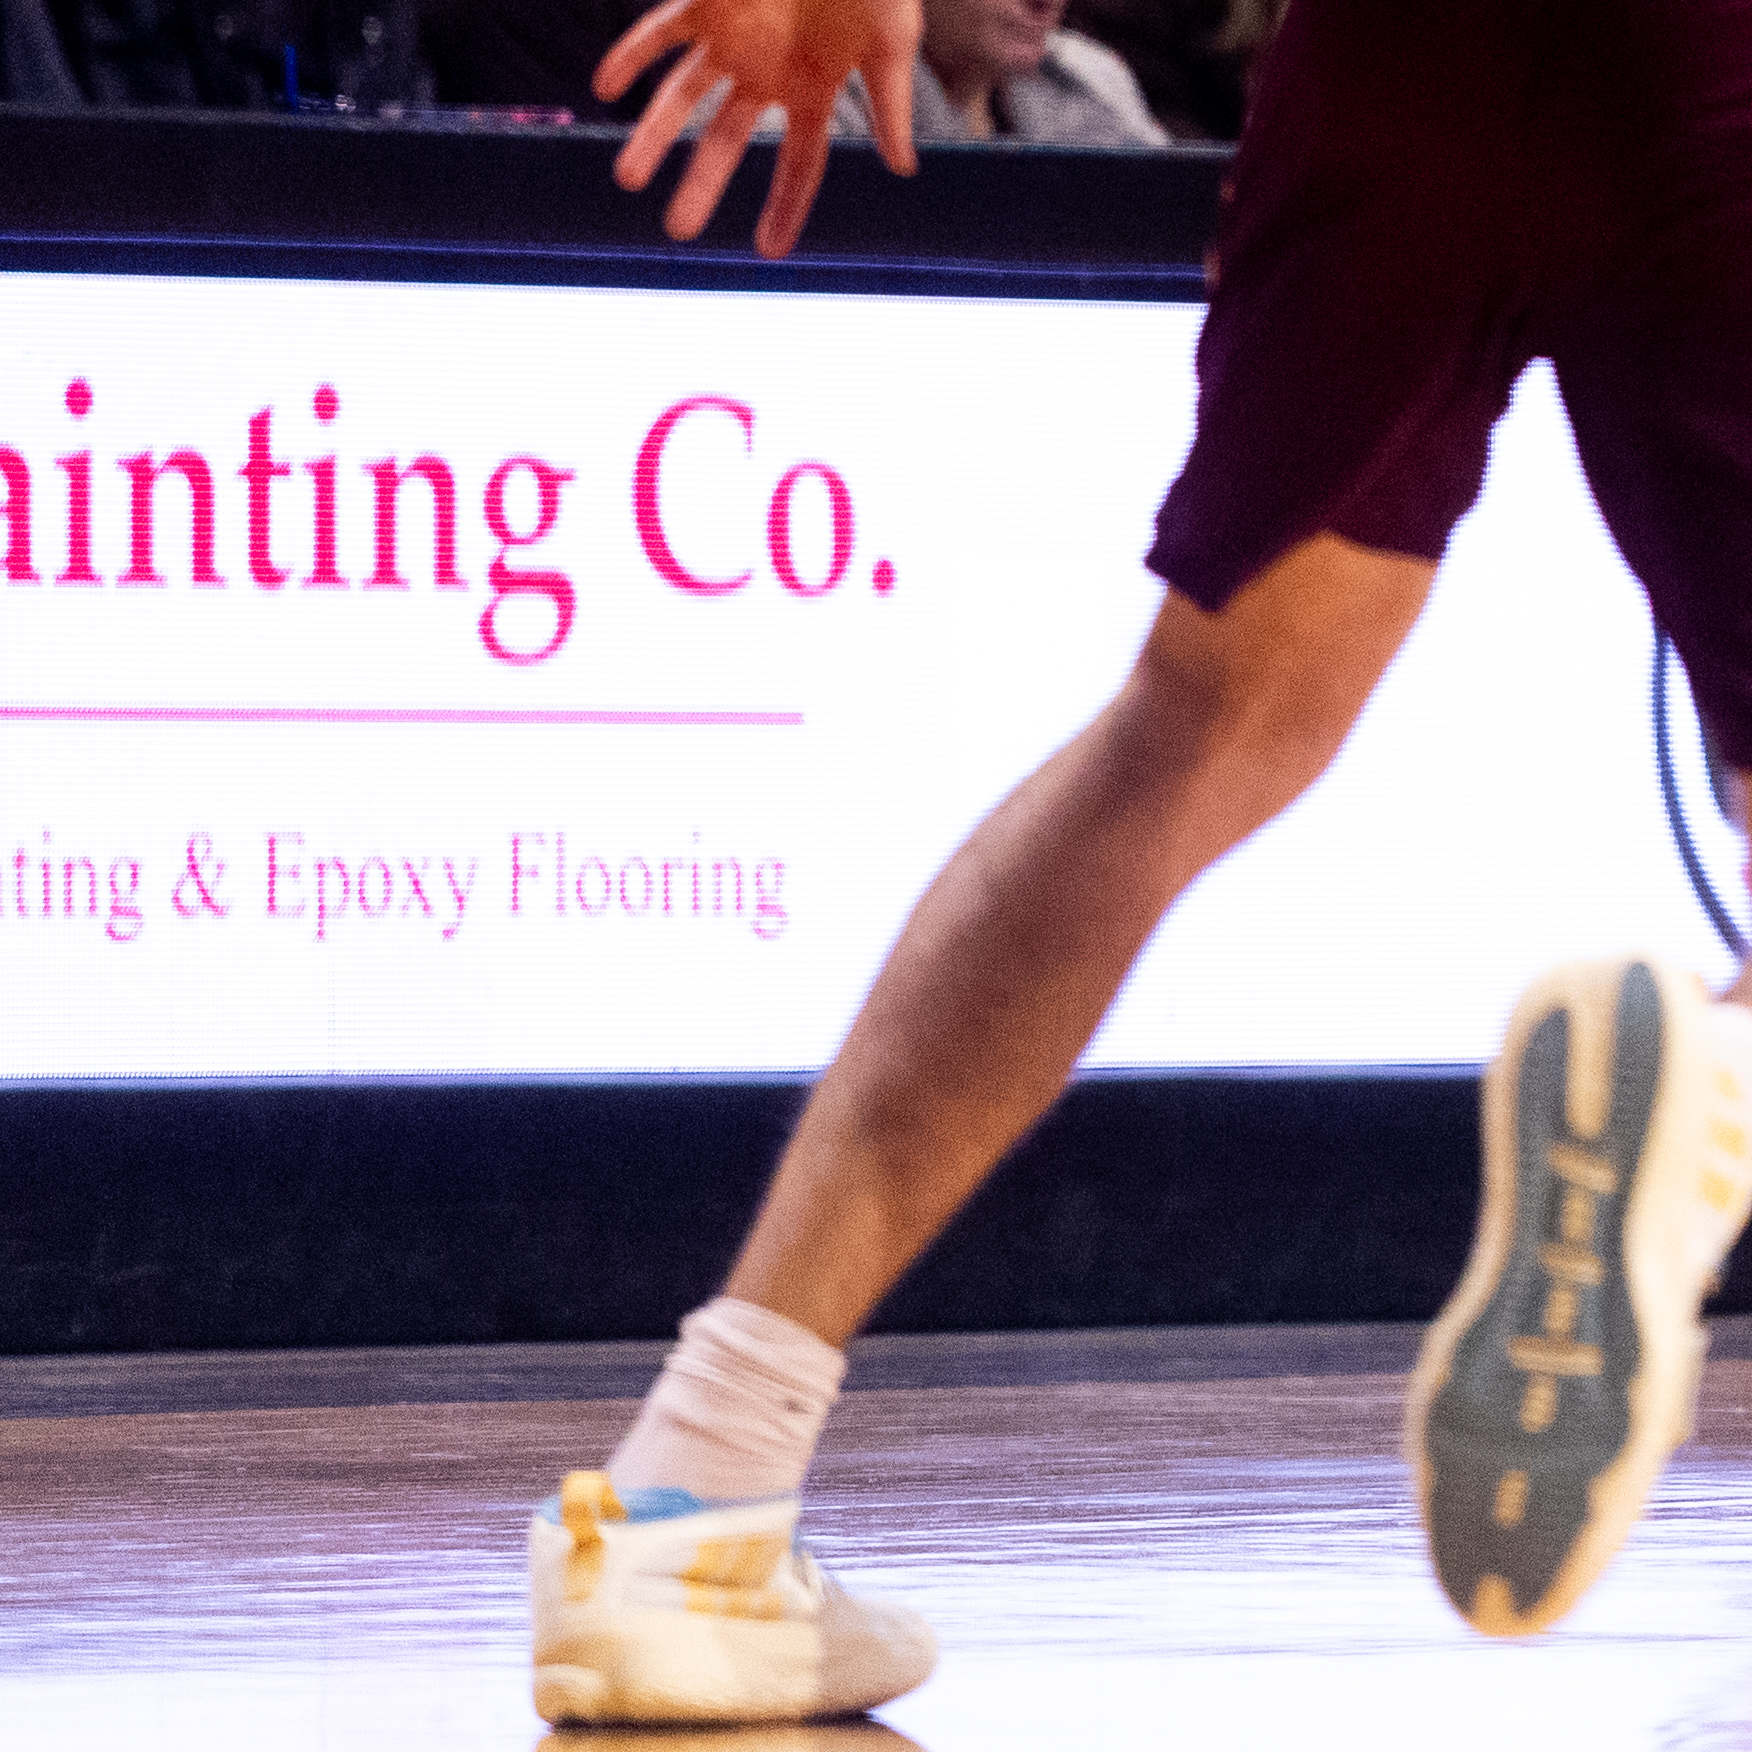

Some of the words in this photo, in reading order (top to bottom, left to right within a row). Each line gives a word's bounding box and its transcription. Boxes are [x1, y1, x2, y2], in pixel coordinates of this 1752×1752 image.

[631, 392, 897, 598] Co.
[171, 830, 231, 920] &
[264, 830, 477, 942] Epoxy
[508, 828, 790, 942] Flooring
